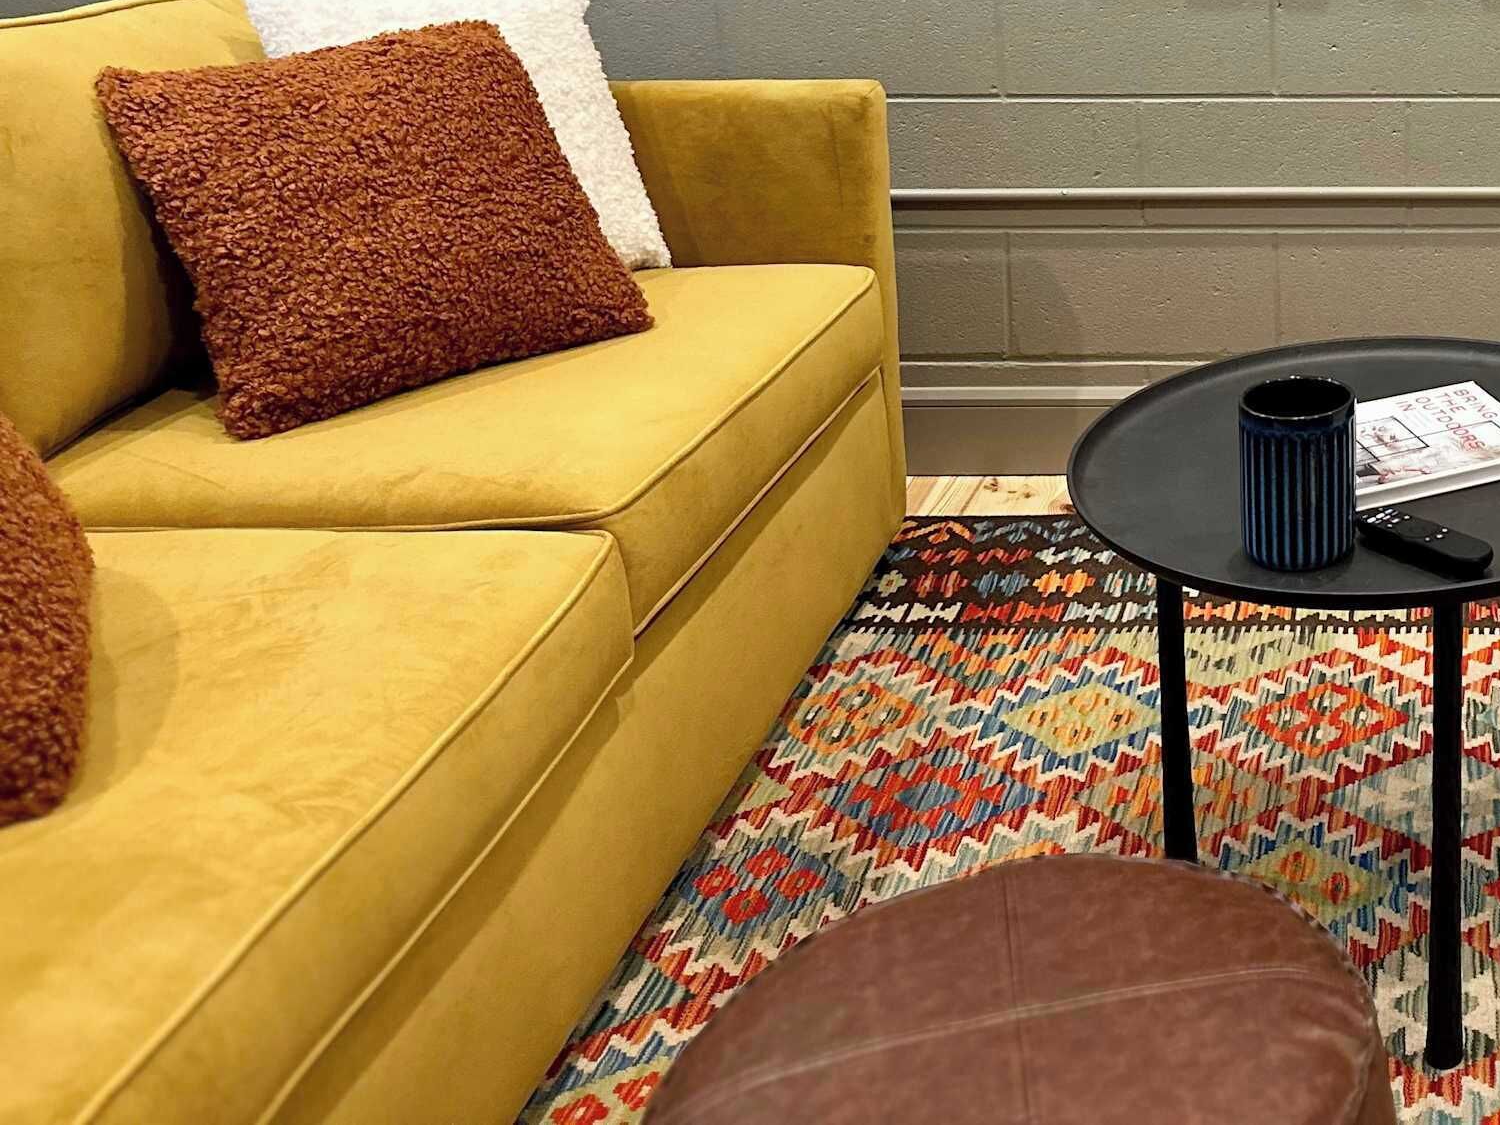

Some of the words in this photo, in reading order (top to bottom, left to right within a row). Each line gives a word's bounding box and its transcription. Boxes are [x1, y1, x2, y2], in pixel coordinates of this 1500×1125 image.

[1396, 400, 1417, 412] IN
[1435, 392, 1467, 414] THE
[1454, 388, 1498, 420] BRING
[1415, 396, 1486, 451] OUTDOORS
